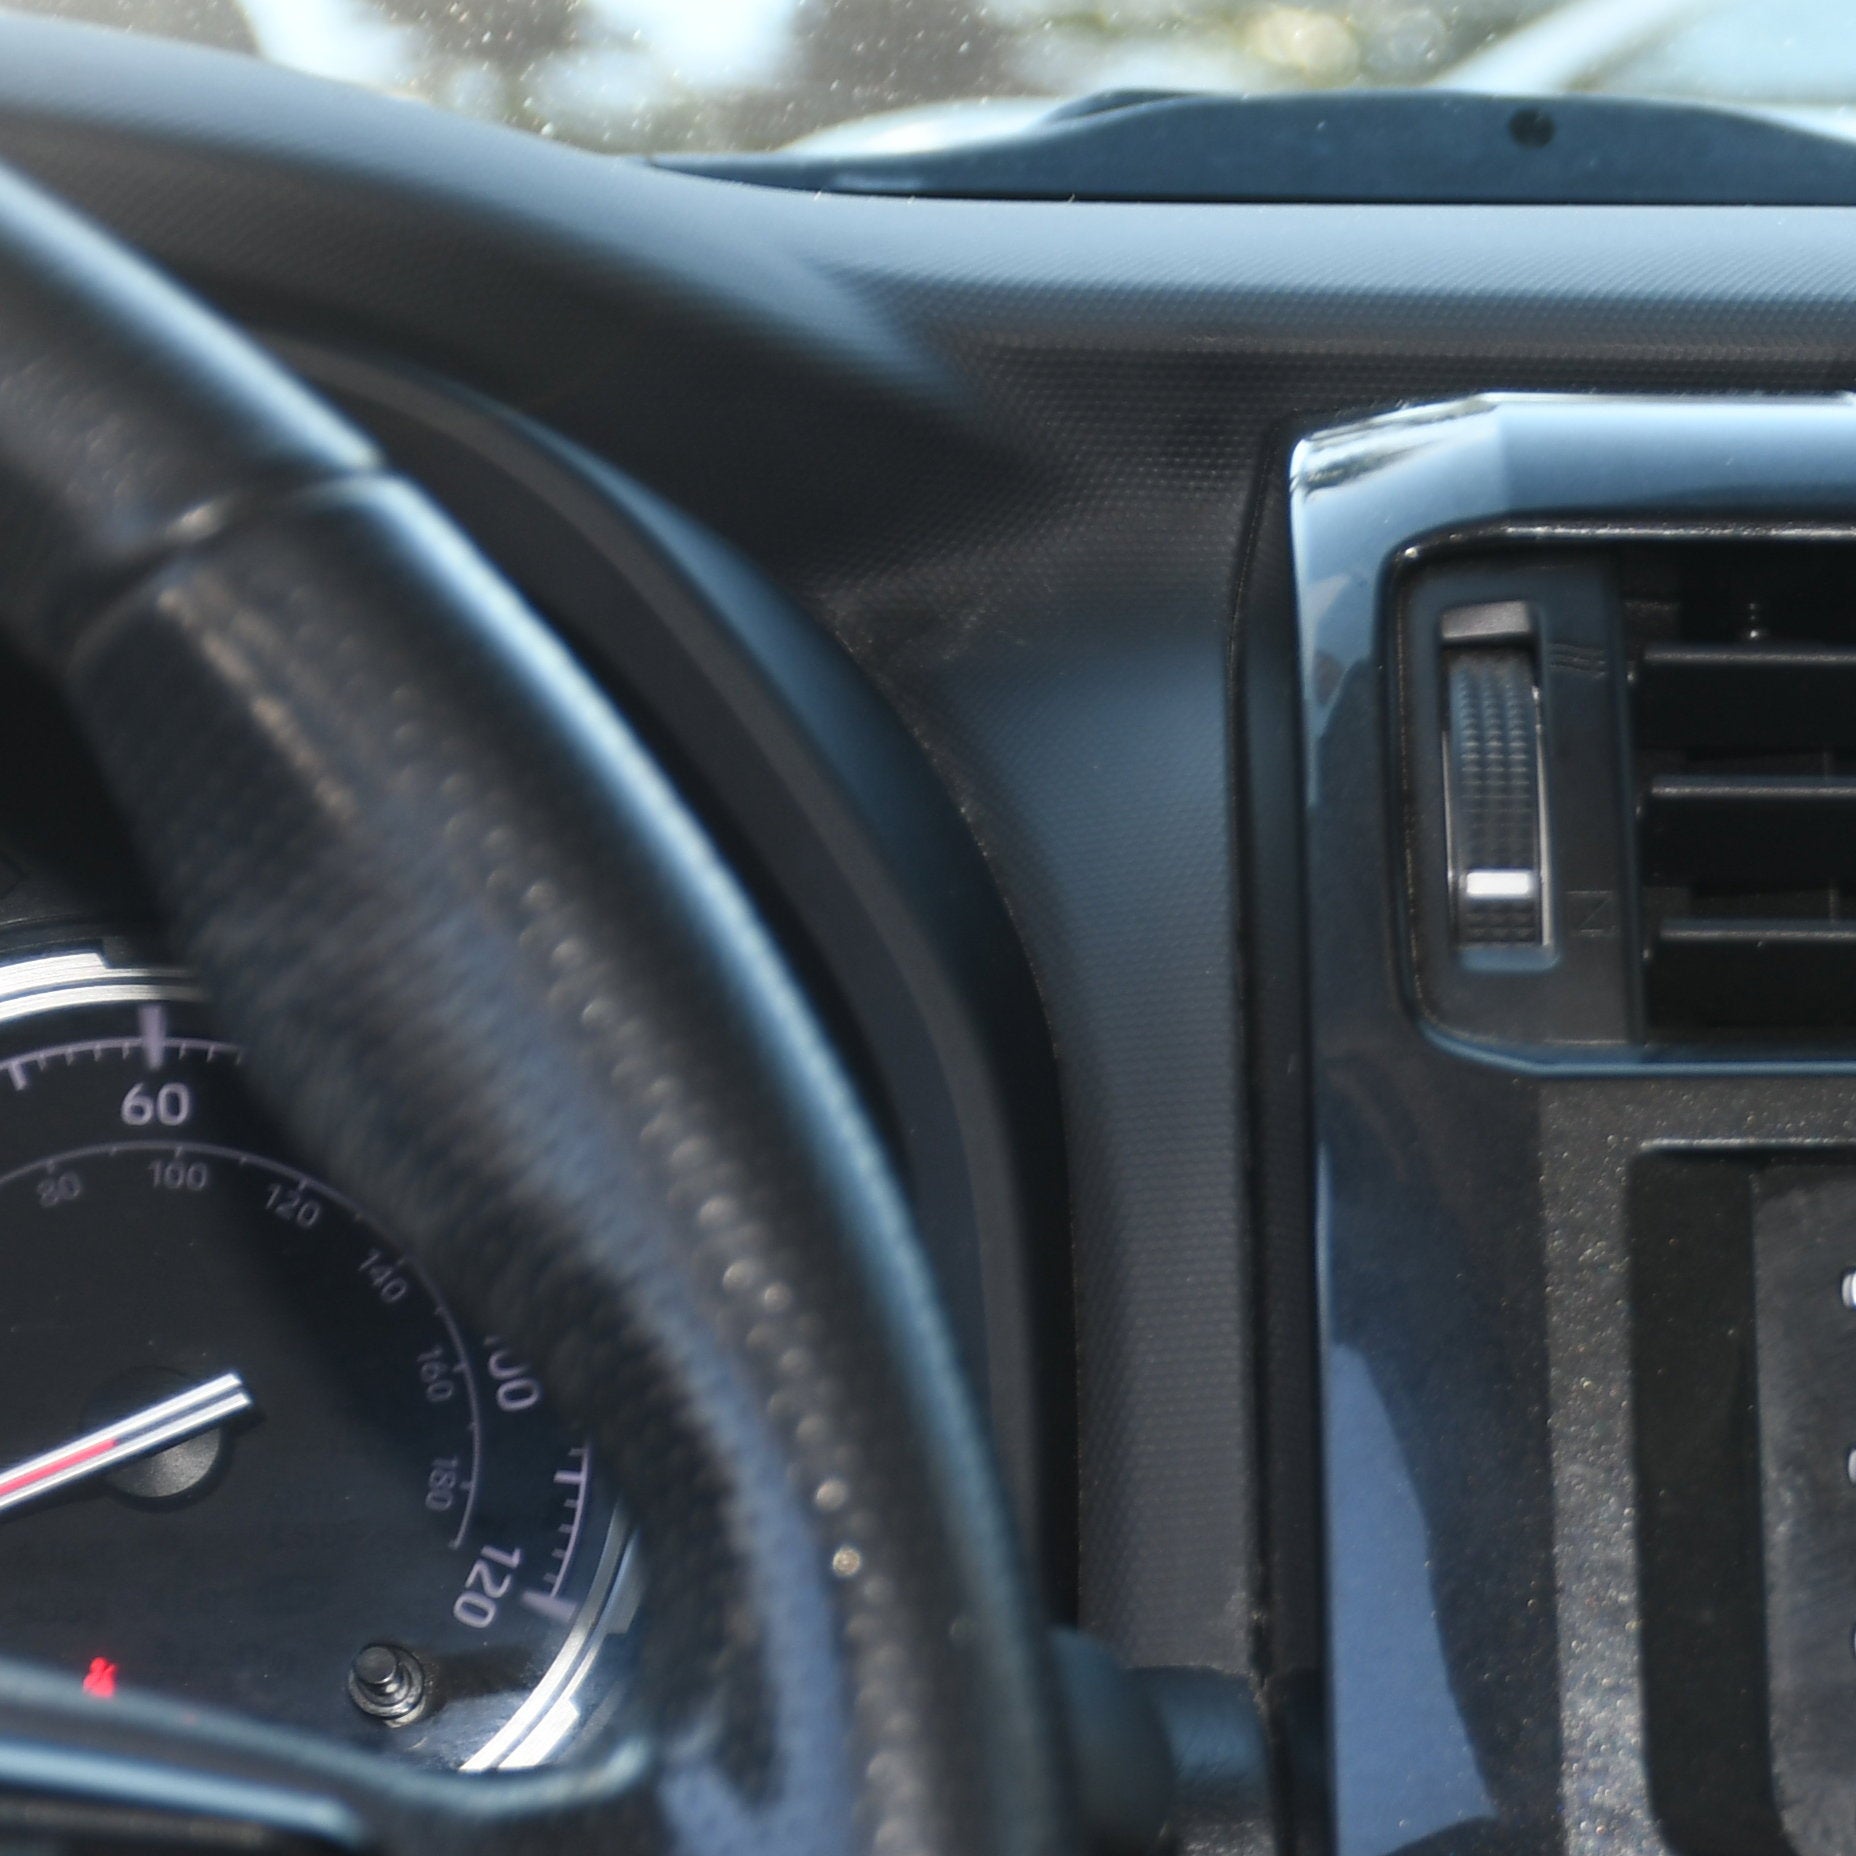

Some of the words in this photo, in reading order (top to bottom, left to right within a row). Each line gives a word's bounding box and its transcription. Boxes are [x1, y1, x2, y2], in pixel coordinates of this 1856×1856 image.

[120, 1081, 192, 1128] 60
[147, 1157, 211, 1193] 100
[264, 1181, 323, 1230] 120
[356, 1247, 410, 1305] 140
[415, 1343, 454, 1403] 160
[424, 1455, 460, 1512] 180
[452, 1542, 523, 1630] 120
